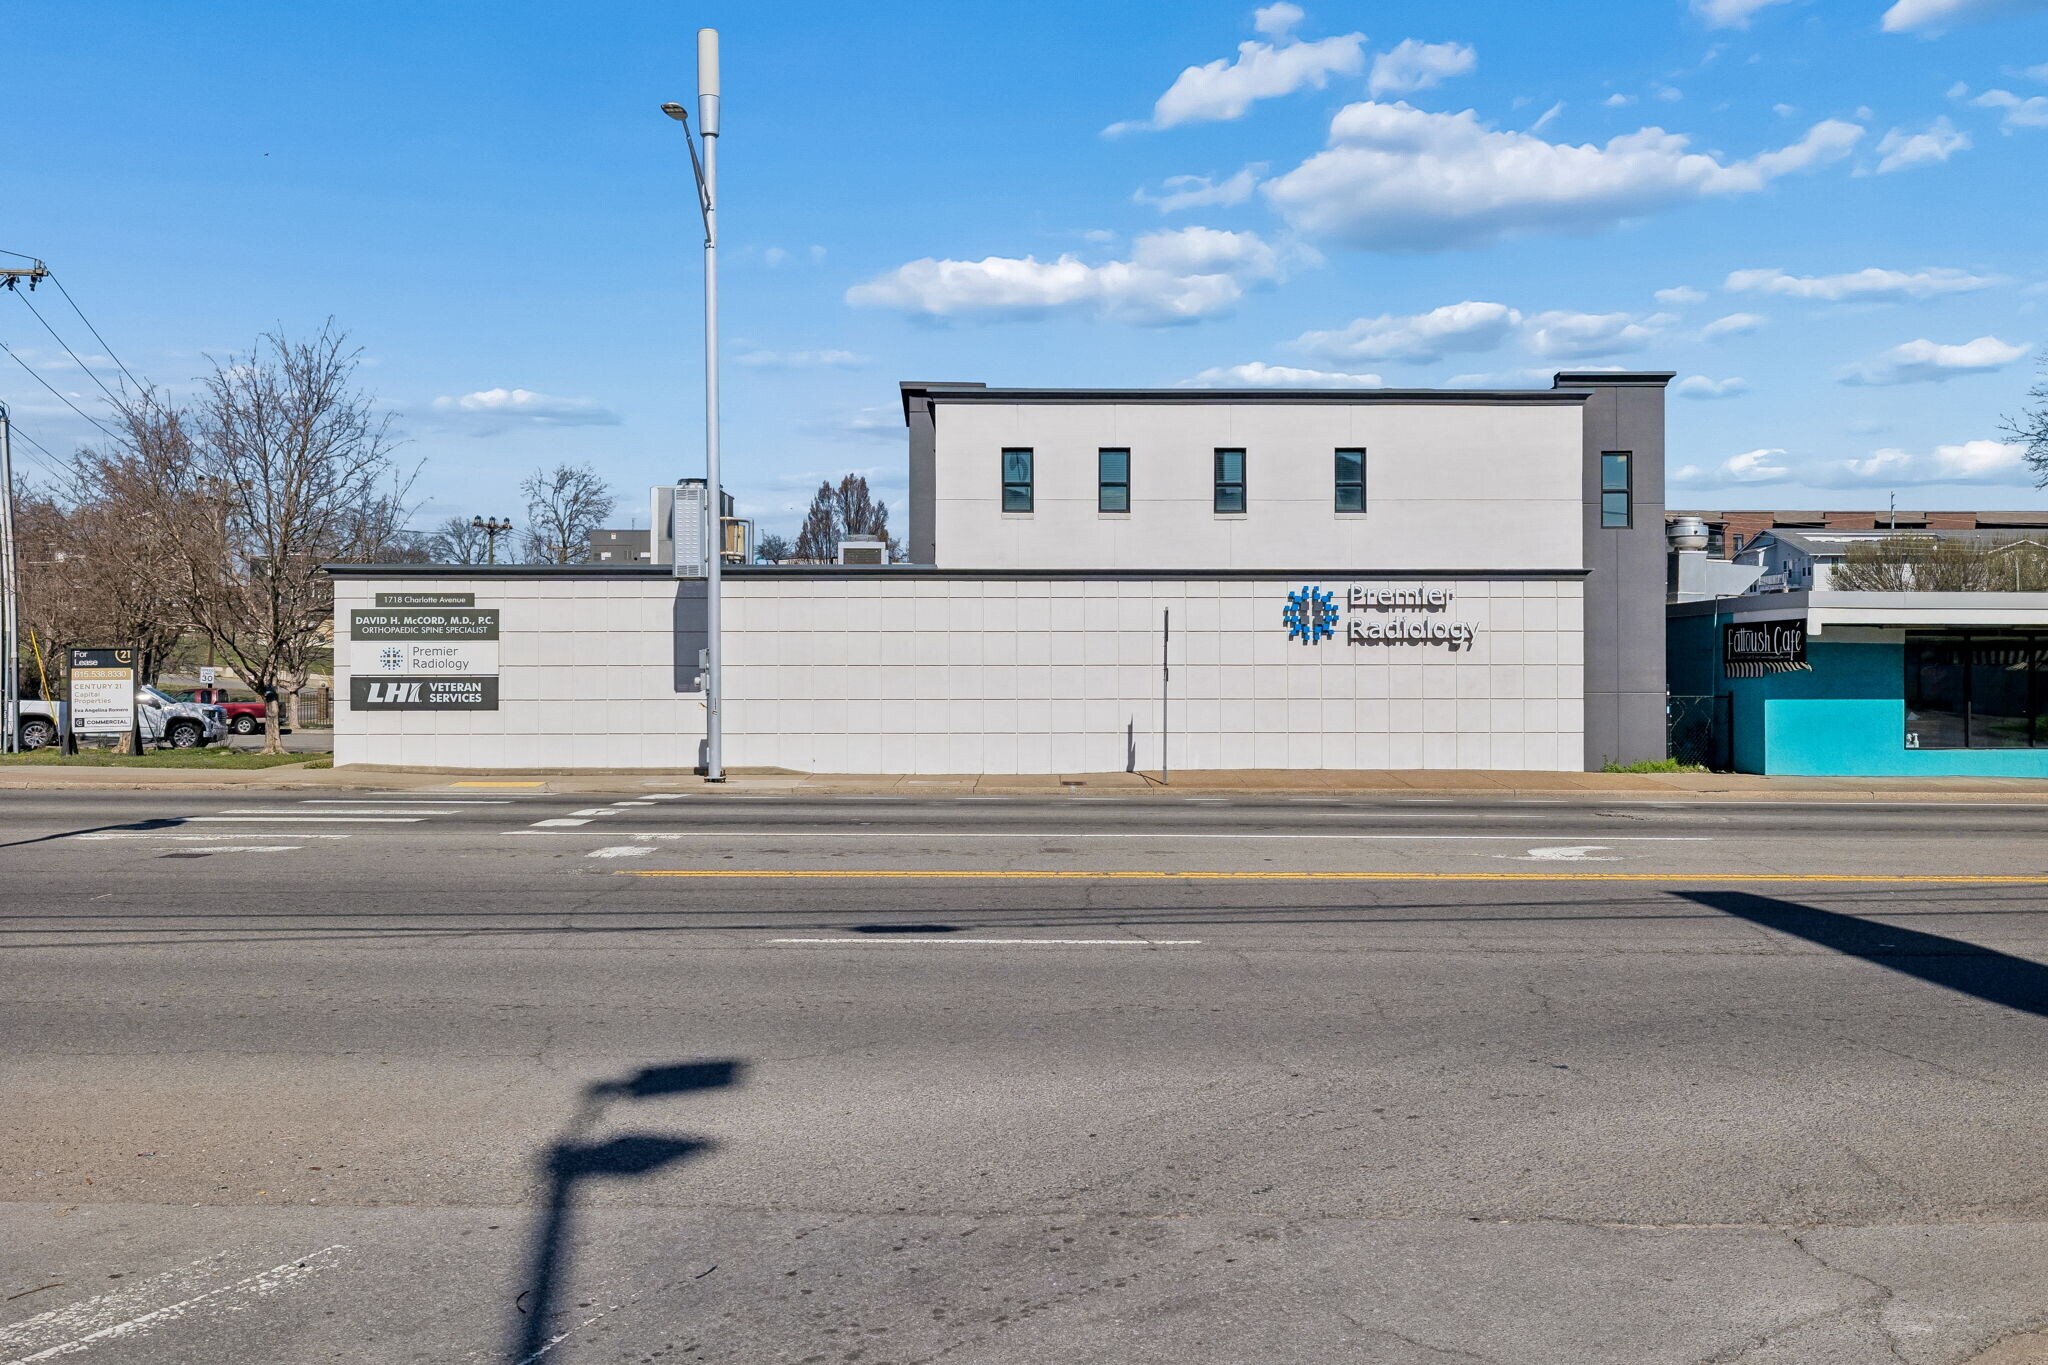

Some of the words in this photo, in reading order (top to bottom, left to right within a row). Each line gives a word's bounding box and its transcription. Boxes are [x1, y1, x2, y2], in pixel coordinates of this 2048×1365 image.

[1350, 583, 1455, 605] Premier
[384, 596, 403, 604] 1718
[404, 596, 438, 604] Charlotte
[439, 596, 466, 604] Avenue
[355, 616, 388, 625] DAVID
[390, 616, 401, 625] H.
[403, 616, 448, 627] McCORD,
[450, 616, 476, 627] M.D.,
[478, 616, 494, 625] P.C.
[361, 626, 420, 634] ORTHOPAEDIC
[421, 626, 444, 634] SPINE
[445, 626, 488, 634] SPECIALIST
[1350, 616, 1480, 644] Radiology
[1773, 622, 1802, 661] Café
[74, 650, 88, 658] For
[412, 646, 459, 656] Premier
[74, 658, 98, 666] Lease
[412, 658, 469, 670] Radiology
[429, 682, 482, 692] VETERAN
[429, 693, 482, 703] SERVICES
